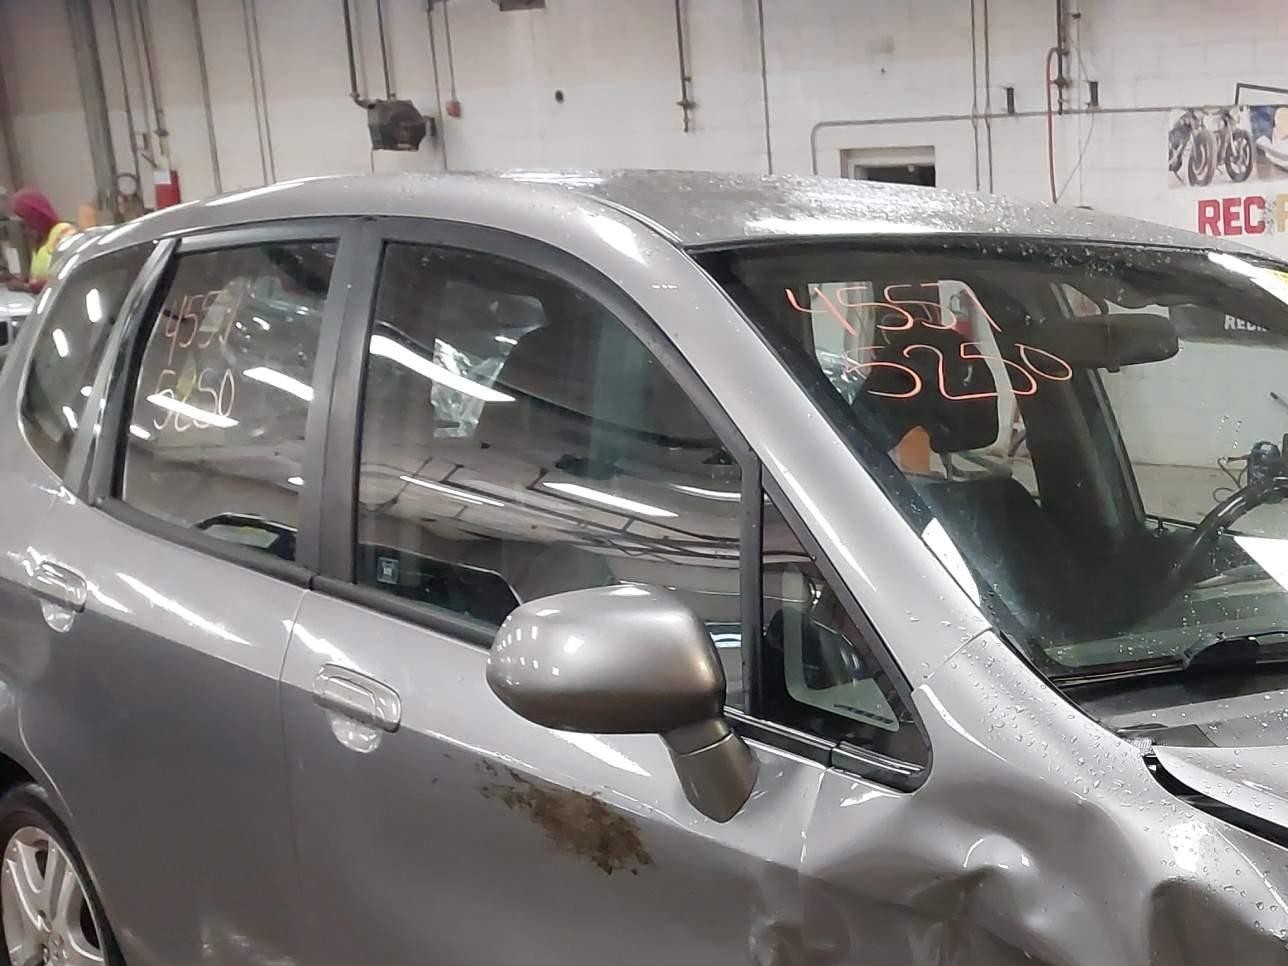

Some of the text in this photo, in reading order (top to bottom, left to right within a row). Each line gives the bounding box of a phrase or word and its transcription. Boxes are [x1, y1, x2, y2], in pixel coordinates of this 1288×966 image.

[1198, 196, 1266, 237] REC
[785, 283, 1002, 336] 4557
[845, 342, 1072, 399] 5250
